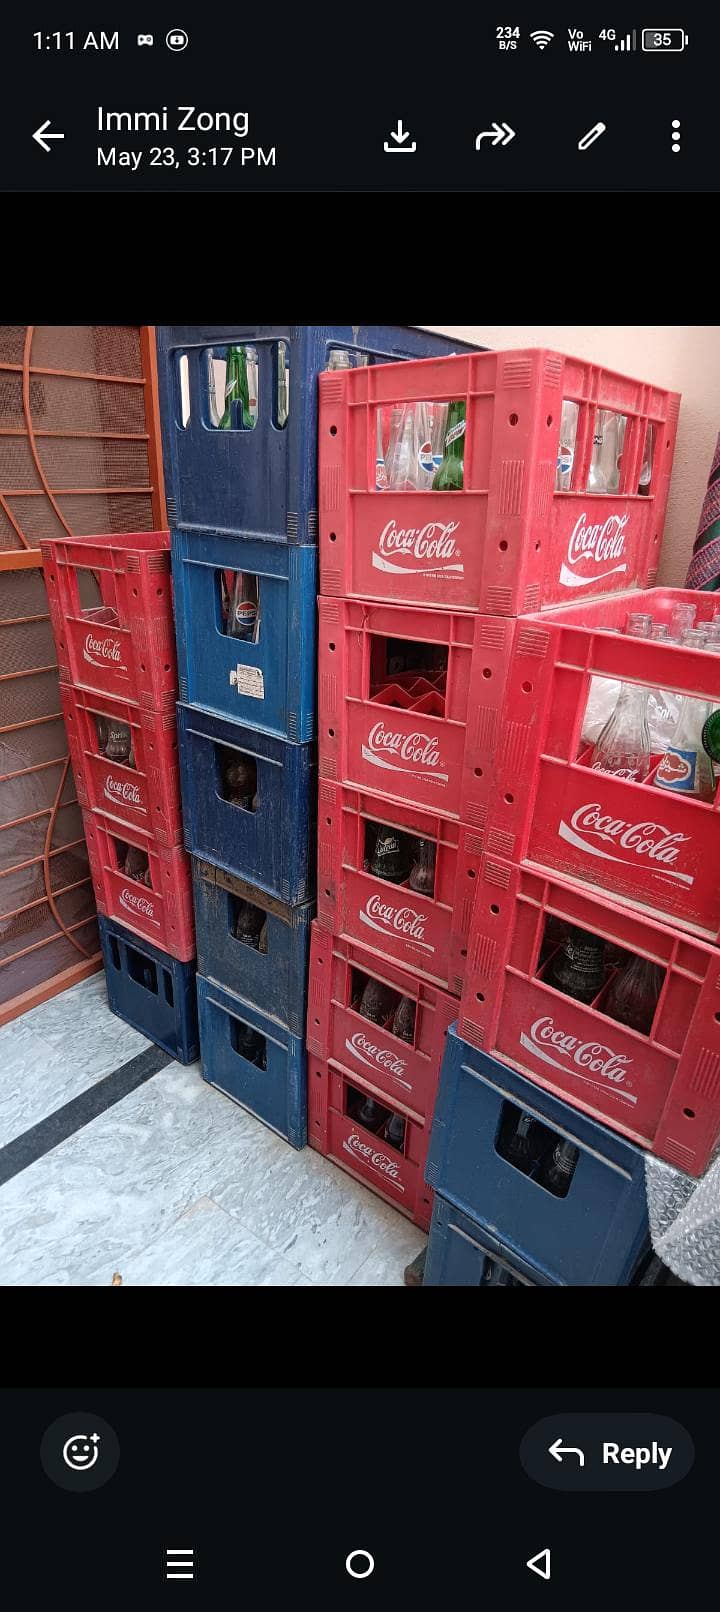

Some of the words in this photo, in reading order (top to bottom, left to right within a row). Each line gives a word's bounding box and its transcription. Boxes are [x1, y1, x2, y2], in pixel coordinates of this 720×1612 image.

[379, 519, 460, 559] Coca-Cola
[567, 512, 630, 563] Coca-Cola
[85, 633, 123, 662] Coca-Cola
[367, 721, 443, 767] Coca-Cola
[106, 775, 141, 804] Coca-Cola
[570, 803, 693, 865] Coca-Cola
[122, 888, 154, 918] Coca-Cola
[366, 894, 428, 940] Coca-Cola
[350, 1032, 408, 1077] Coca-Cola
[530, 1016, 634, 1084] Coca-Cola
[347, 1134, 402, 1179] Coca-Cola
